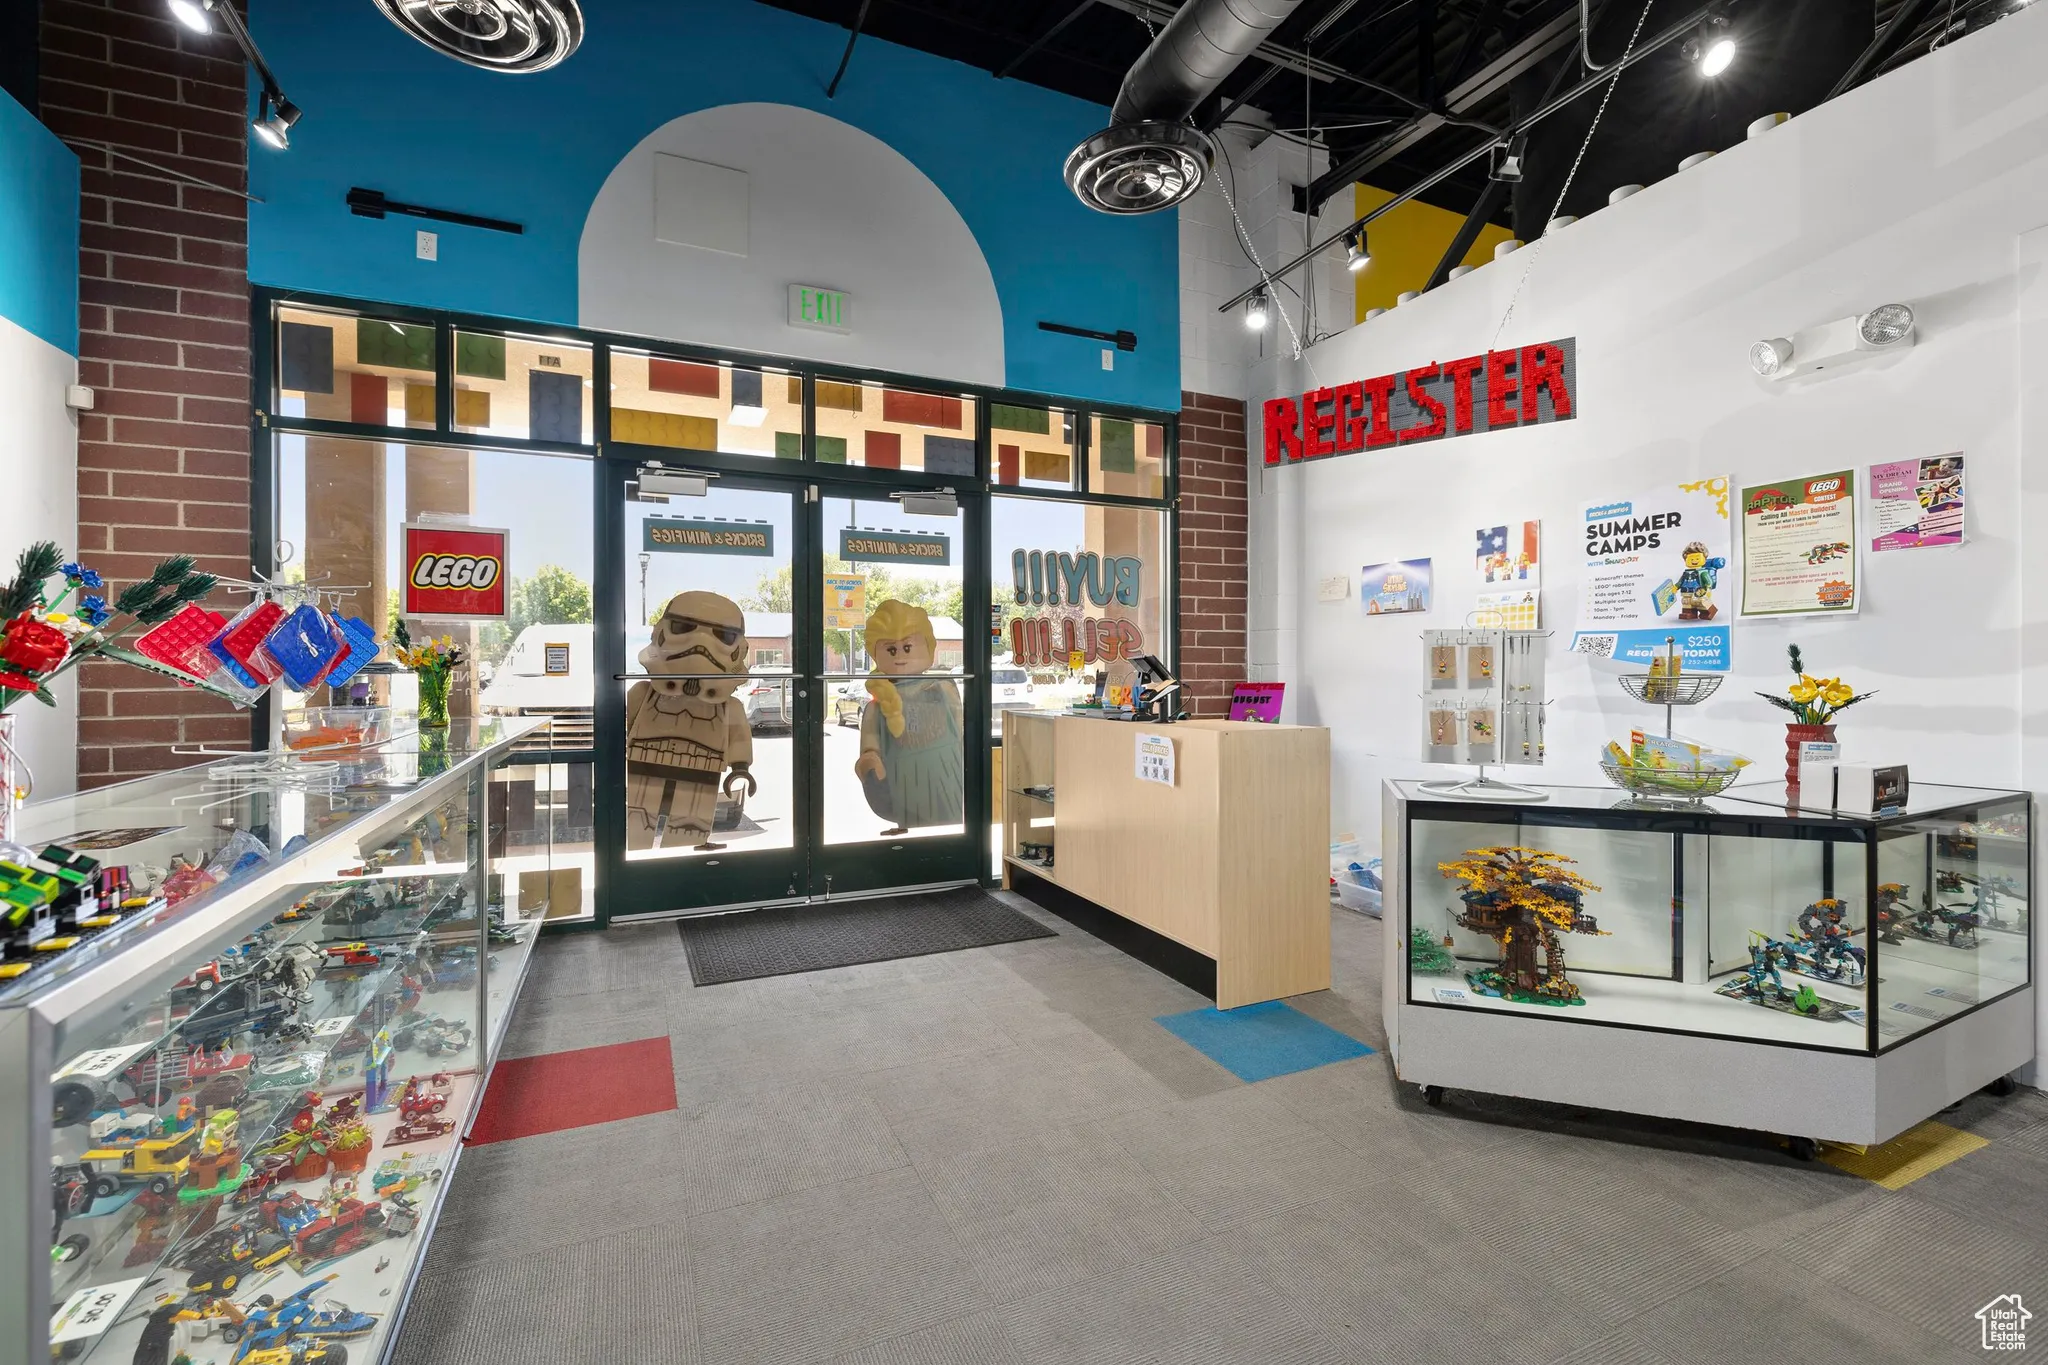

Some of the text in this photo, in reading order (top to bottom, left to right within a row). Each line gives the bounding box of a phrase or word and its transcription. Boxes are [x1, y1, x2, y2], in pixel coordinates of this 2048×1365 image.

[801, 288, 843, 326] EXIT
[1264, 342, 1571, 464] REGISTER
[1810, 478, 1840, 494] LEGO
[1879, 481, 1902, 489] GRAND
[1879, 486, 1908, 494] OPENING
[1746, 494, 1797, 511] RAPTOR
[1814, 493, 1836, 502] CONTEST
[1810, 505, 1836, 513] Builders!
[1586, 512, 1682, 540] SUMMER
[1586, 533, 1660, 556] CAMPS
[411, 553, 500, 591] LEGO
[1688, 635, 1721, 647] $250
[1233, 696, 1271, 704] AUGUST
[1647, 739, 1679, 749] CREATOR
